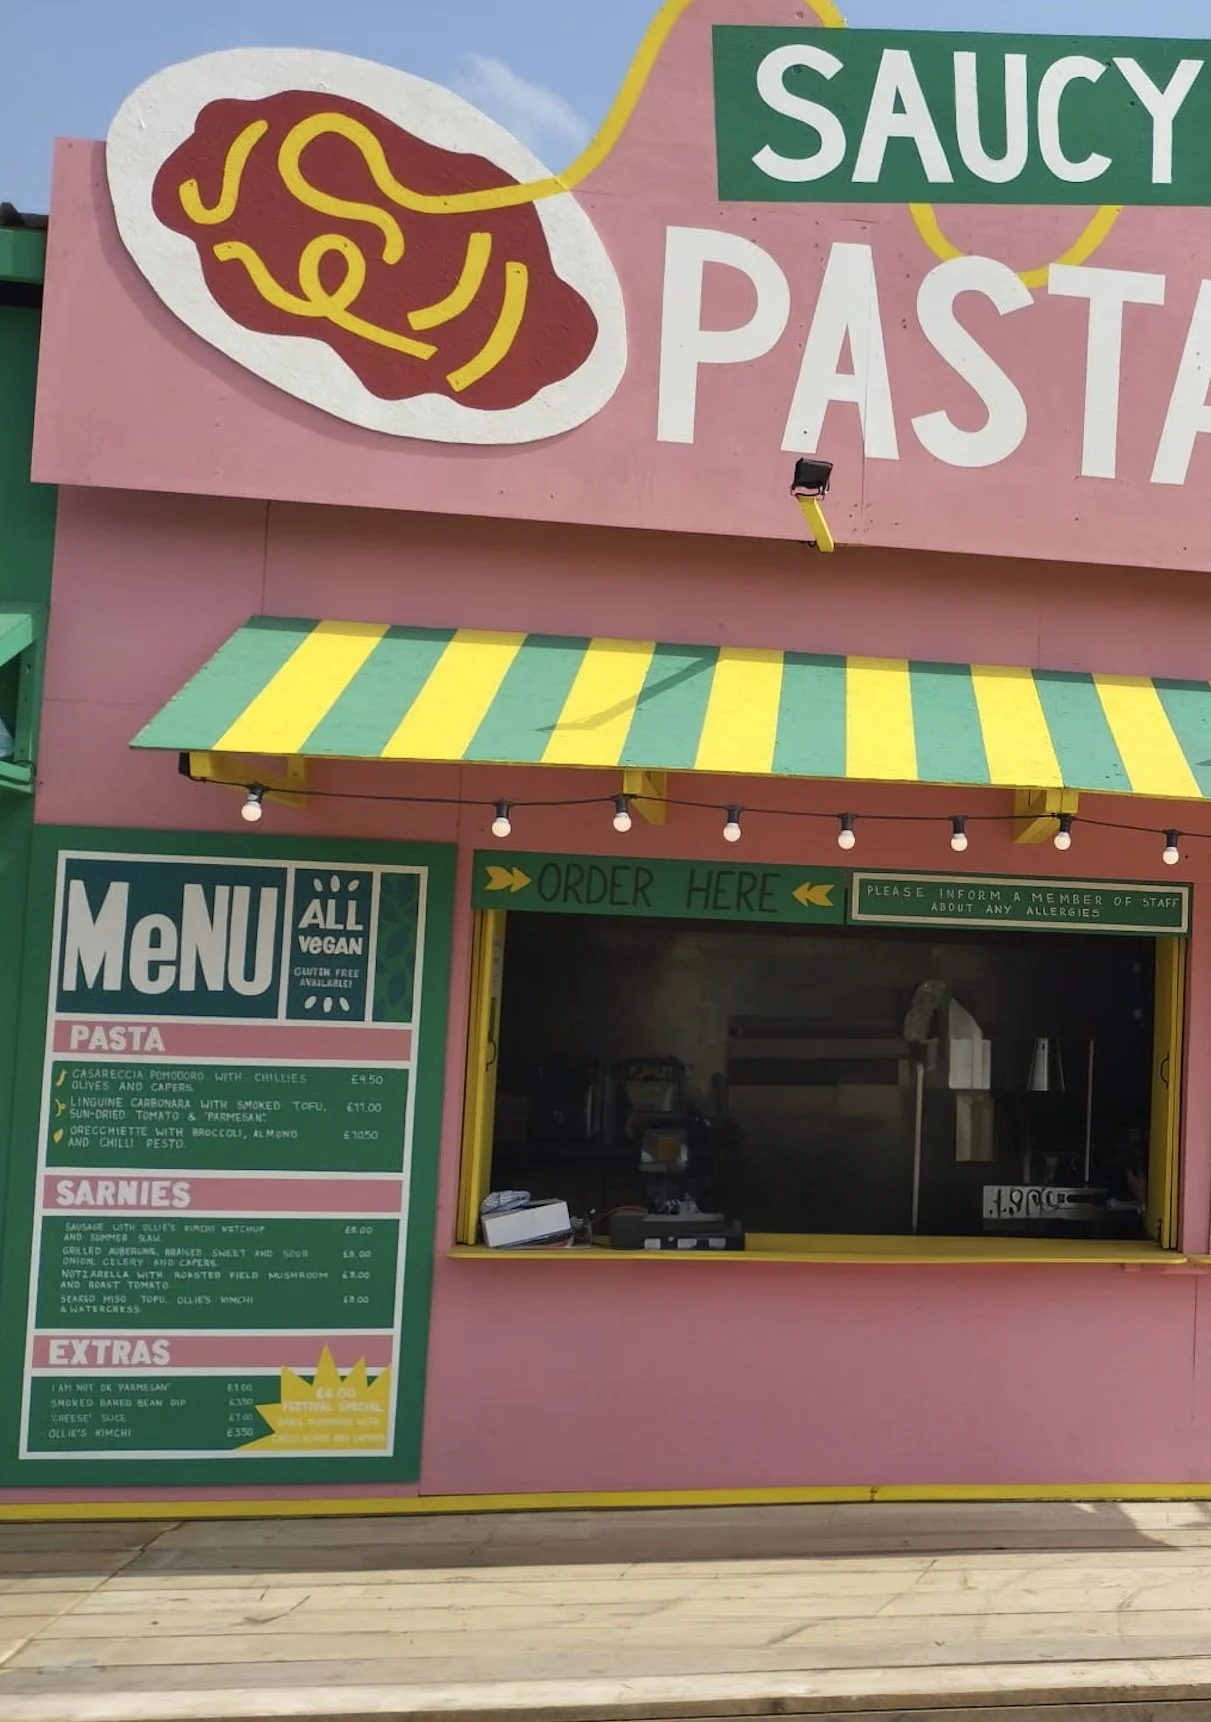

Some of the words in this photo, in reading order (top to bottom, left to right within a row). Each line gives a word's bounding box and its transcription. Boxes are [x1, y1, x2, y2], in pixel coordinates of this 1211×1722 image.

[751, 44, 1205, 183] SAUCY
[538, 862, 653, 907] ORDER
[686, 869, 781, 913] HERE
[867, 884, 925, 898] PLEASE
[939, 888, 1000, 901] INFORM
[1013, 891, 1021, 902] A
[1032, 892, 1103, 905] MEMBER
[1113, 895, 1132, 907] OF
[1142, 897, 1180, 909] STAFF
[298, 898, 364, 931] ALL
[930, 902, 972, 913] ABOUT
[985, 905, 1012, 914] ANY
[1026, 905, 1101, 918] ALLERGIES
[62, 879, 278, 996] MeNU
[293, 966, 331, 977] GLUTEN
[335, 968, 359, 977] FREE
[299, 978, 352, 988] AVAILABLE!
[69, 1025, 165, 1052] PASTA
[72, 1069, 143, 1080] CASARECCIA
[150, 1070, 204, 1081] POMODORO
[214, 1072, 242, 1082] WITH
[254, 1073, 307, 1084] CHILLIES
[72, 1081, 109, 1090] OLIVES
[120, 1082, 142, 1091] AND
[70, 1096, 123, 1108] LINGUINE
[130, 1098, 190, 1108] CARBONARA
[200, 1100, 227, 1109] WITH
[237, 1101, 280, 1110] SMOKED
[346, 1103, 382, 1112] £11.00
[70, 1109, 125, 1119] SUN-DRIED
[136, 1110, 179, 1120] TOMATO
[188, 1112, 196, 1121] &
[70, 1125, 148, 1135] ORECCHIETTE
[155, 1127, 183, 1137] WITH
[253, 1130, 298, 1139] ALMOND
[68, 1138, 89, 1147] AND
[100, 1138, 133, 1148] CHILLI
[56, 1180, 190, 1209] SARNIES
[65, 1223, 103, 1231] SAUSAGE
[222, 1226, 265, 1234] KETCHUP
[90, 1234, 128, 1242] SUMMER
[63, 1247, 101, 1255] GRILLED
[165, 1248, 202, 1256] BRAISED
[212, 1249, 246, 1257] SWEET
[254, 1249, 273, 1257] AND
[282, 1249, 309, 1258] SOUR
[174, 1271, 221, 1279] ROASTED
[89, 1281, 120, 1289] ROAST
[61, 1295, 95, 1303] SEARED
[103, 1295, 126, 1303] MISO
[49, 1339, 170, 1366] EXTRAS
[58, 1384, 71, 1392] AM
[51, 1399, 93, 1408] SMOKED
[283, 1402, 333, 1412] FESTIVAL
[338, 1402, 383, 1412] SPECIAL
[48, 1429, 88, 1438] OLLIE'S
[95, 1429, 131, 1437] KIMCHI
